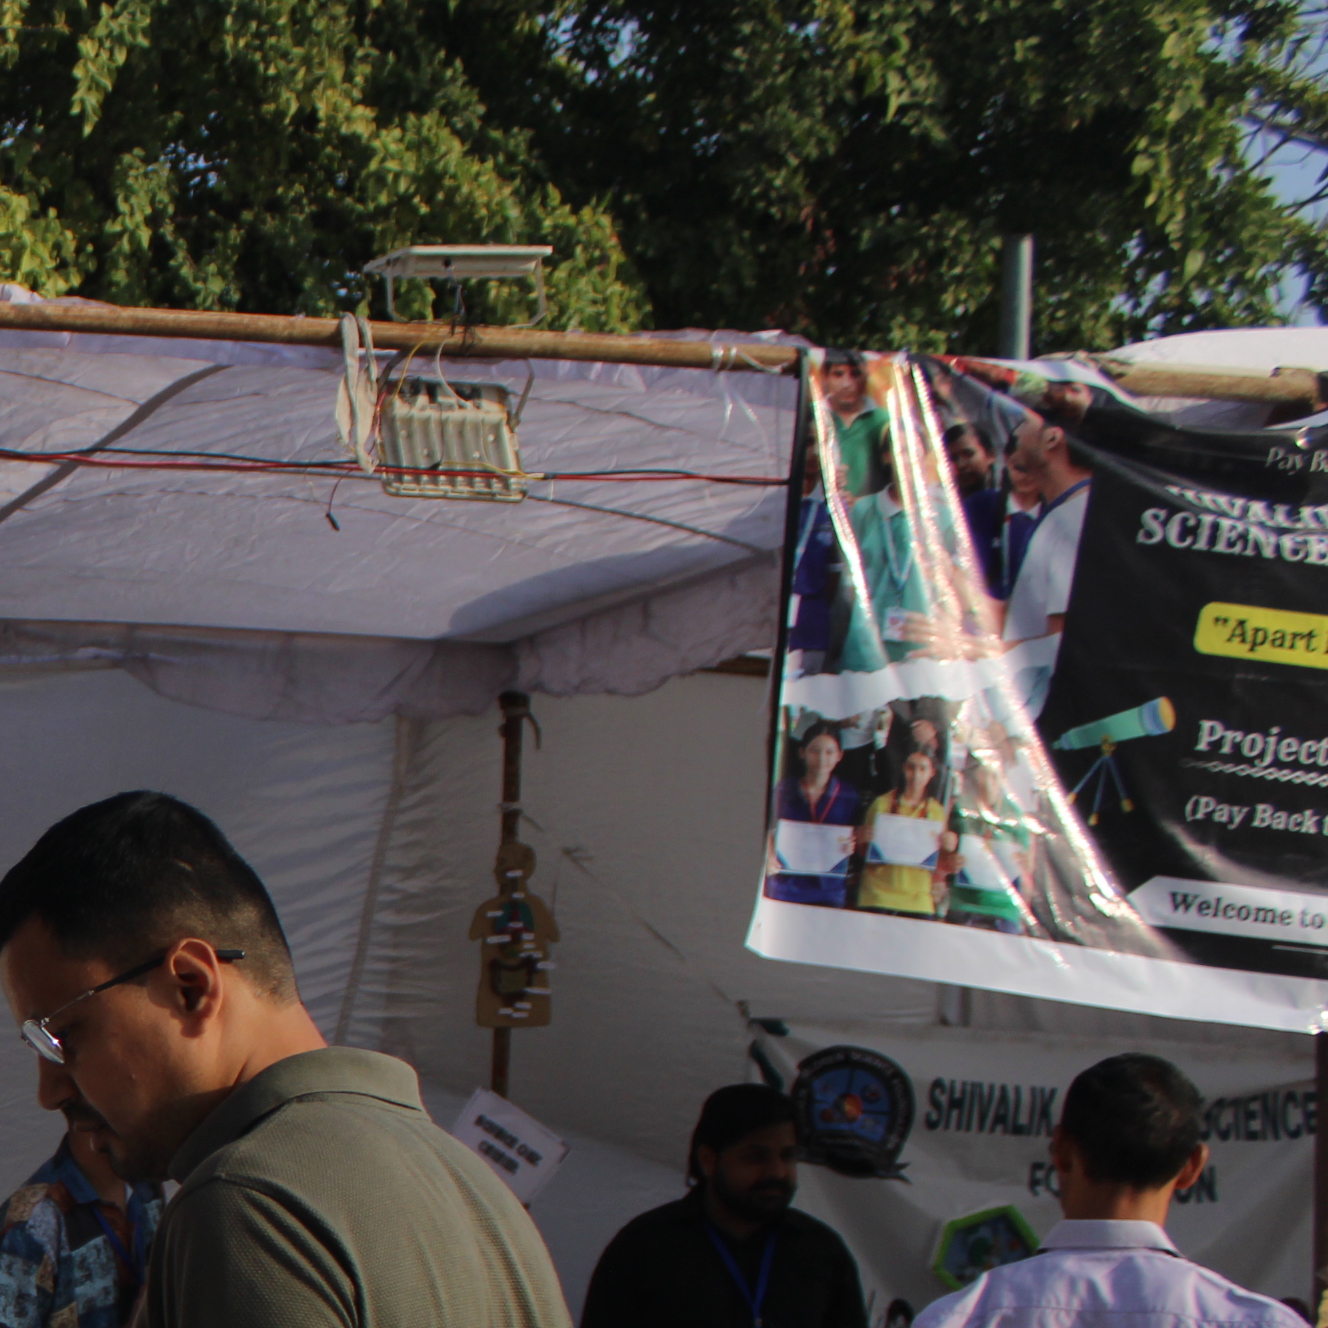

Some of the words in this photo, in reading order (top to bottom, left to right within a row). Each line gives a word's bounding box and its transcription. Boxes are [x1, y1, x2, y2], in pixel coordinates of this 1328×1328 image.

[1136, 507, 1328, 566] SCIENCE
[1185, 795, 1250, 829] (Pay
[1251, 803, 1318, 835] Back
[1168, 890, 1292, 927] Welcome
[1301, 909, 1325, 930] to
[925, 1077, 1058, 1138] SHIVALIK
